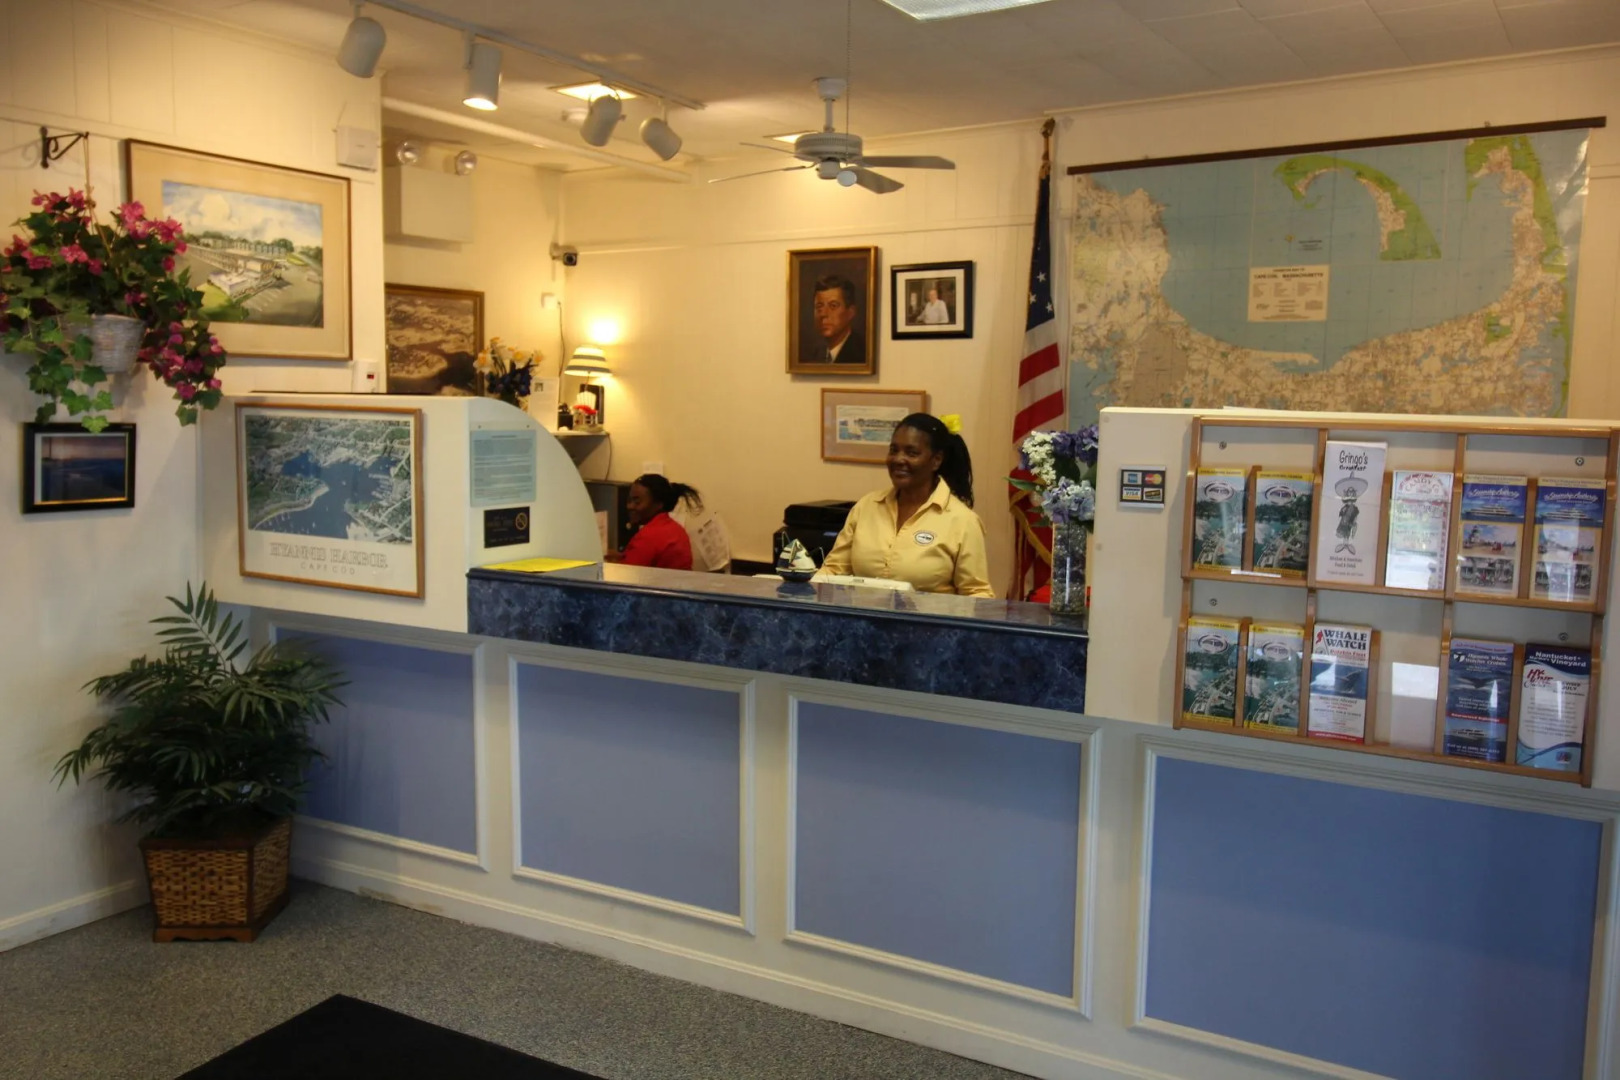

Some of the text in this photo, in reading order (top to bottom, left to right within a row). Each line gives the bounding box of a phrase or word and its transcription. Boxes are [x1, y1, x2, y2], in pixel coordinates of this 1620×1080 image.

[1339, 449, 1368, 465] Gringo's
[269, 542, 388, 569] HYANNIS HARBOR
[332, 565, 355, 575] COD
[1323, 629, 1367, 642] WHALE
[1326, 639, 1367, 650] WATCH
[1535, 651, 1577, 661] Nantucket
[1550, 658, 1587, 667] Vineyard
